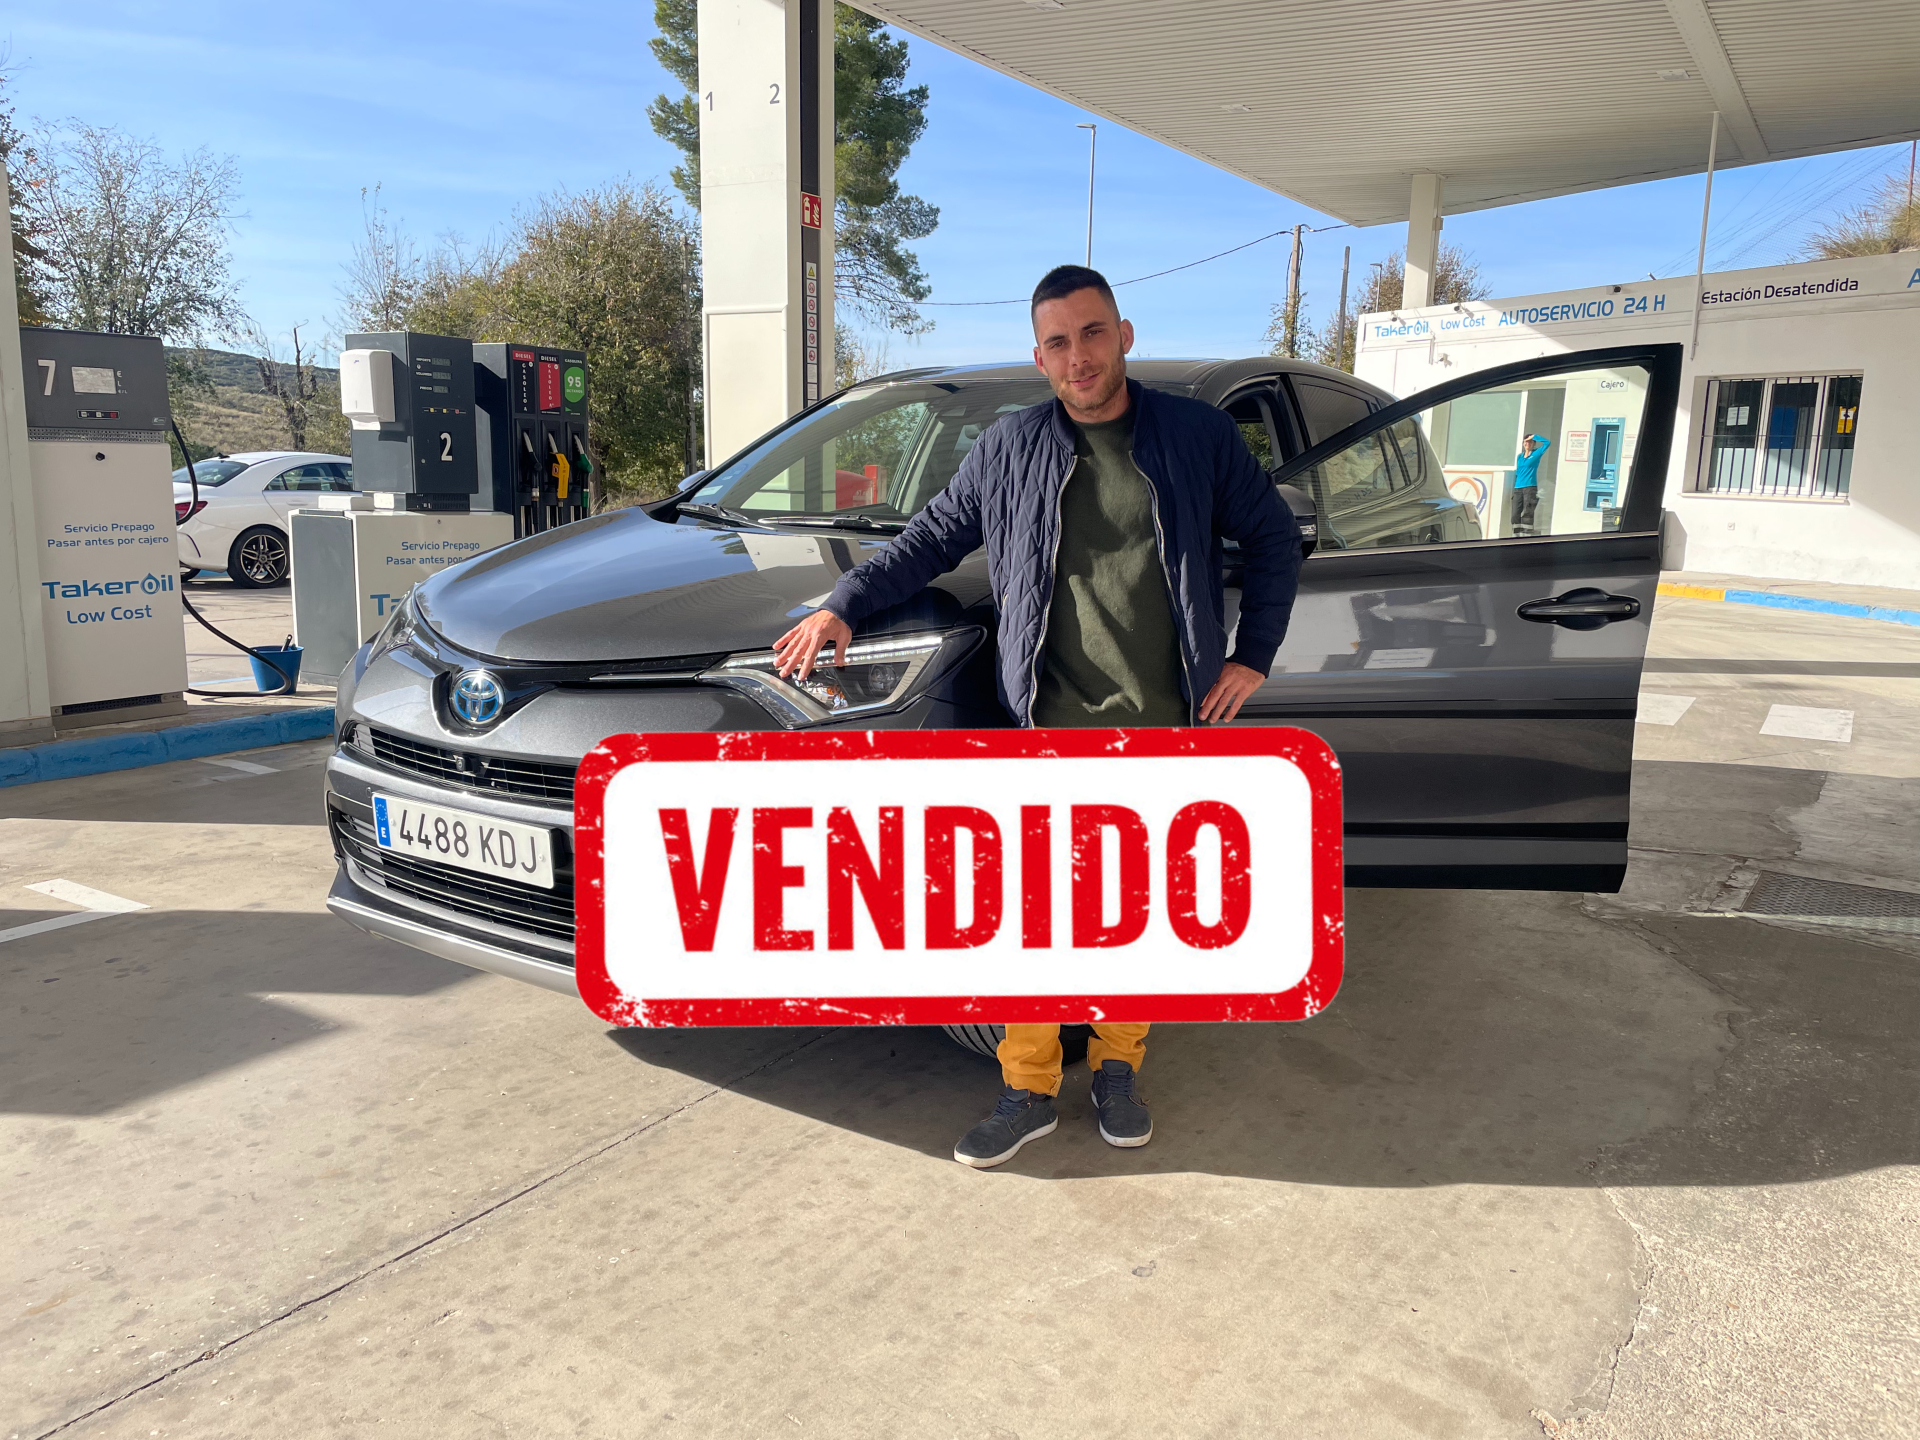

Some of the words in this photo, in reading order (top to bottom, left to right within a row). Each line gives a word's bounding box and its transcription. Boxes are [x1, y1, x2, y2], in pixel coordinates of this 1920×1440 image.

[705, 91, 713, 112] 1
[769, 83, 780, 105] 2
[1701, 286, 1760, 304] Estación
[1764, 277, 1859, 299] Desatendida
[1440, 319, 1460, 330] Low
[1463, 315, 1485, 328] Cost
[1498, 300, 1614, 327] AUTOSERVICIO
[1623, 296, 1648, 314] 24
[1653, 294, 1666, 312] H
[37, 359, 56, 396] 7
[567, 376, 581, 387] 95
[1600, 380, 1625, 390] Cajero
[440, 432, 453, 461] 2
[64, 523, 108, 533] Servicio
[111, 523, 155, 533] Prepago
[47, 539, 81, 548] Pasar
[85, 537, 114, 546] antes
[117, 537, 135, 546] por
[138, 536, 169, 545] cajero
[401, 541, 440, 551] Servicio
[442, 541, 480, 551] Prepago
[386, 556, 416, 565] Pasar
[419, 555, 445, 565] antes
[66, 610, 105, 624] Low
[110, 604, 152, 620] Cost
[381, 827, 387, 838] E
[399, 809, 470, 858] 4488
[479, 825, 538, 874] KDJ
